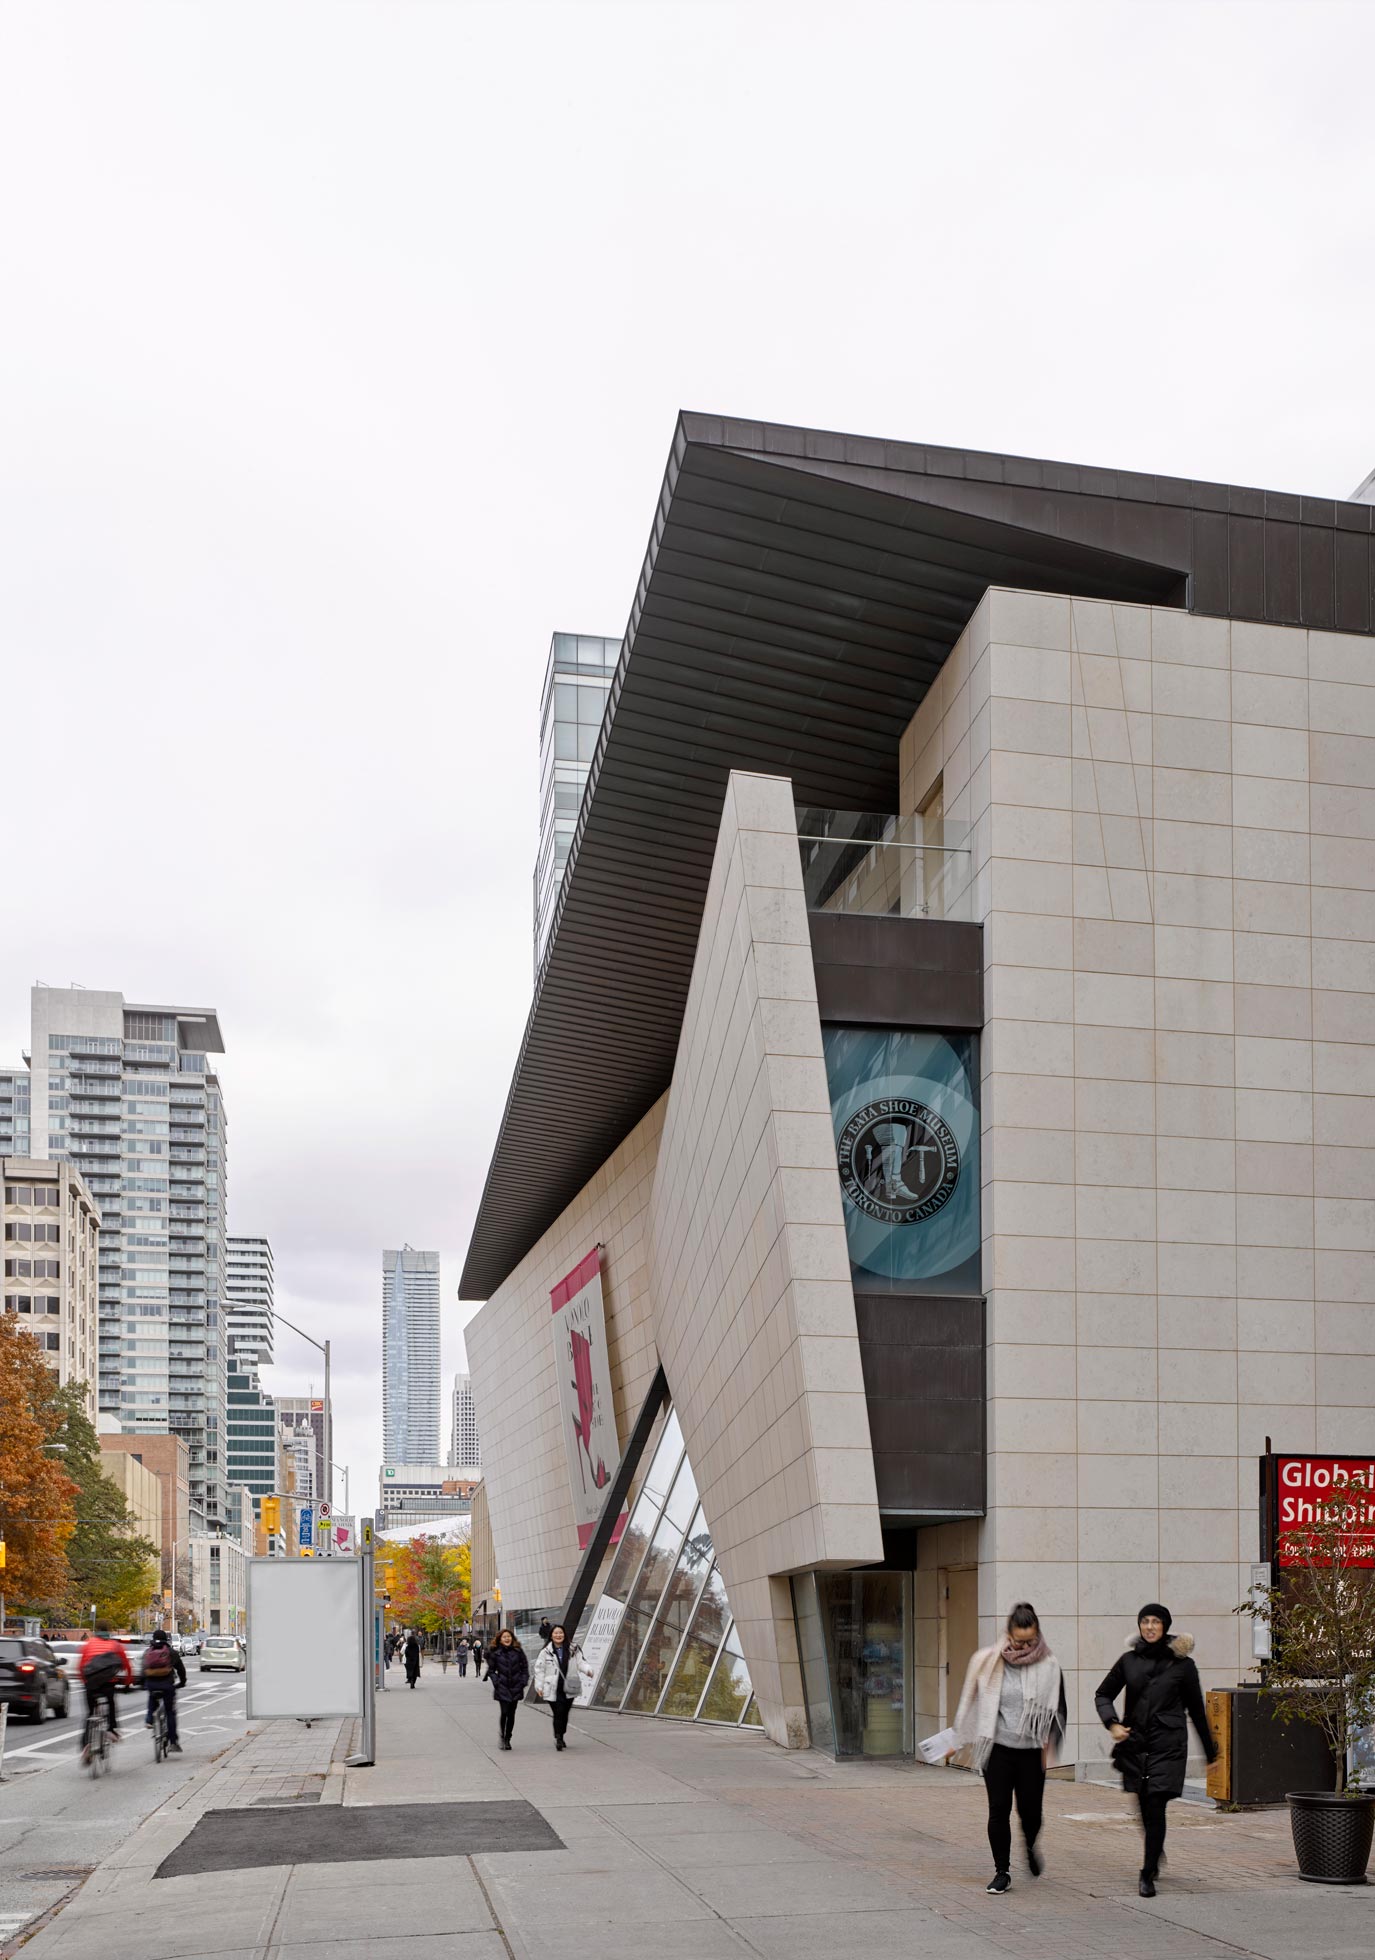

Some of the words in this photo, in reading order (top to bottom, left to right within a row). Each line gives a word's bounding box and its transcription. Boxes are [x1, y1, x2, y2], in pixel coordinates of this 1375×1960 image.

[839, 1133, 853, 1165] THE
[848, 1105, 879, 1135] BATA
[879, 1100, 919, 1115] SHOE
[919, 1109, 958, 1168] MUSEUM
[844, 1177, 902, 1223] TORONTO
[905, 1183, 954, 1222] CANADA
[1282, 1462, 1375, 1488] Global
